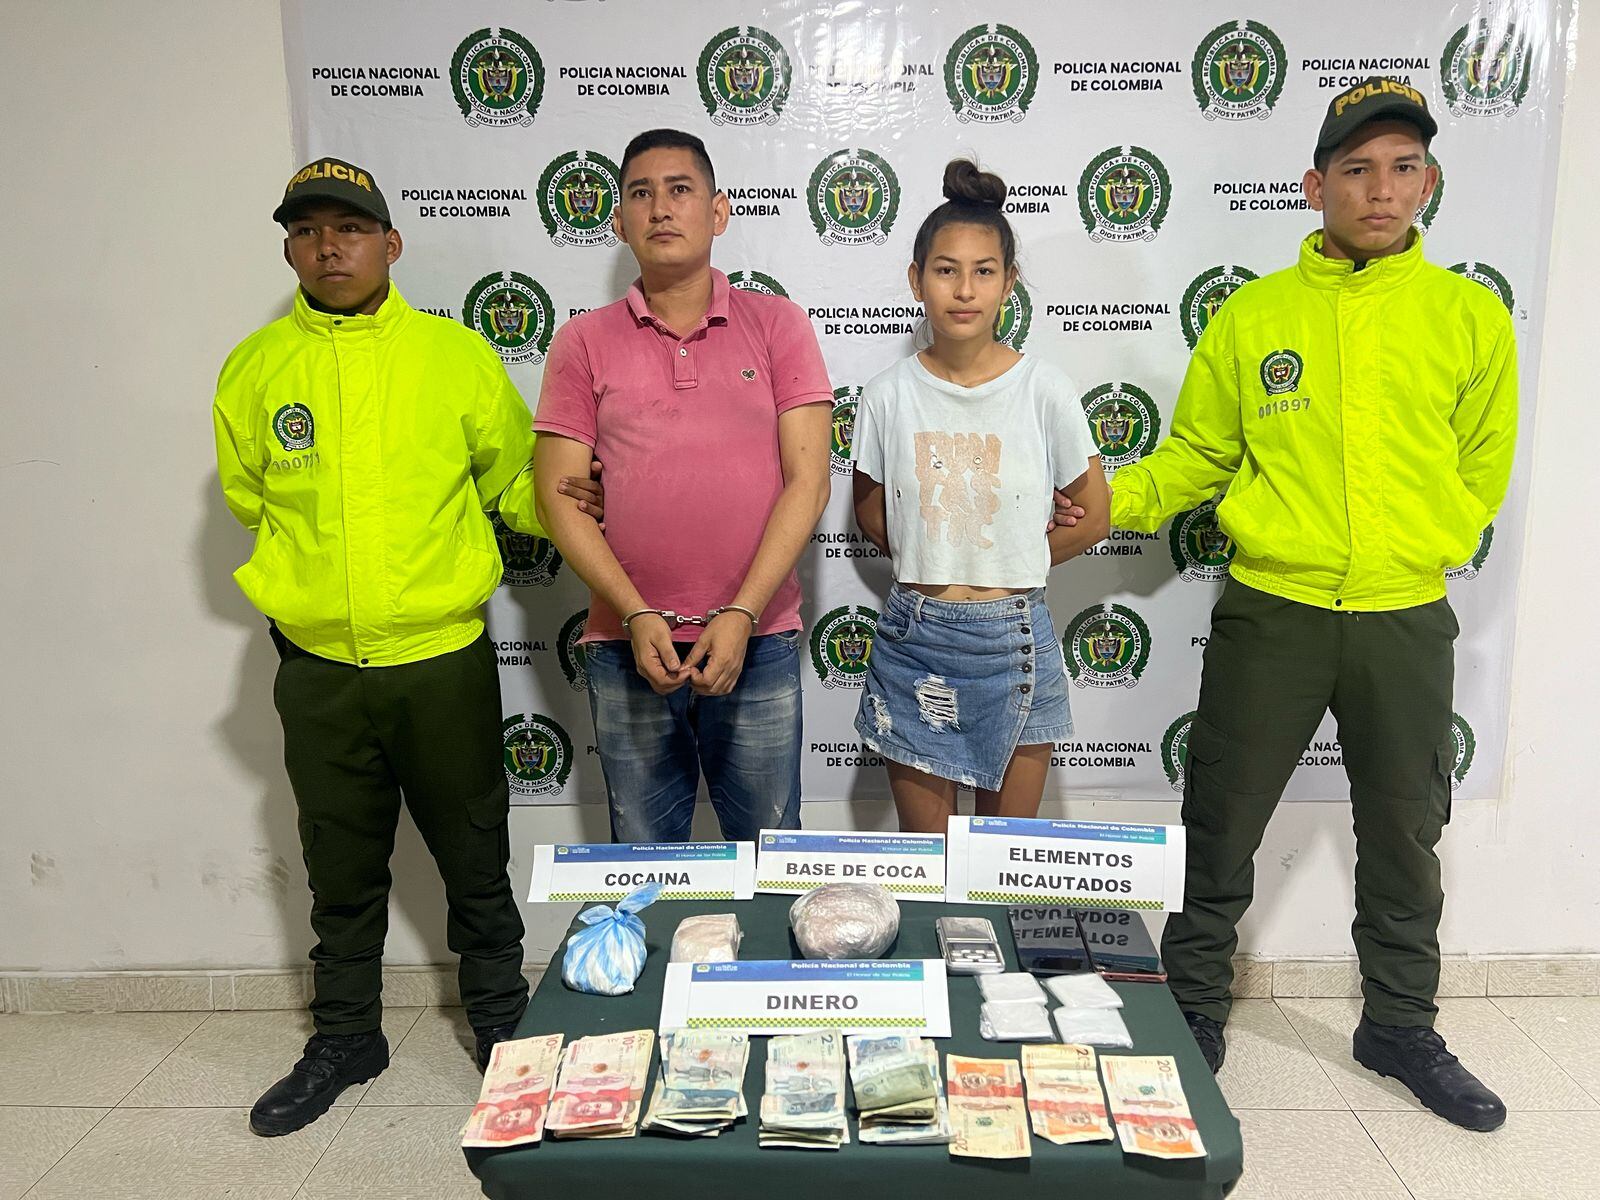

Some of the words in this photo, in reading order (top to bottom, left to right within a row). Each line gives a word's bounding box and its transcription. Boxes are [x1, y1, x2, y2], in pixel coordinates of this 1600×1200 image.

[956, 39, 981, 80] REPUBLICA
[1005, 39, 1027, 79] COLOMBIA
[1203, 35, 1230, 77] REPUBLICA
[1255, 36, 1275, 76] COLOMBIA
[462, 43, 485, 84] REPUBLICA
[509, 43, 533, 83] COLOMBIA
[1055, 63, 1107, 74] POLICIA
[1111, 62, 1181, 73] NACIONAL
[1303, 59, 1355, 70] POLICIA
[1359, 58, 1430, 69] NACIONAL
[313, 68, 365, 79] POLICIA
[369, 68, 440, 79] NACIONAL
[560, 67, 612, 78] POLICIA
[616, 67, 686, 78] NACIONAL
[1071, 80, 1087, 91] DE
[1091, 79, 1162, 90] COLOMBIA
[1319, 77, 1335, 87] DE
[331, 85, 347, 96] DE
[351, 85, 423, 96] COLOMBIA
[578, 85, 594, 95] DE
[598, 84, 669, 95] COLOMBIA
[991, 88, 1024, 112] NACIONAL
[1237, 85, 1271, 109] NACIONAL
[1335, 80, 1423, 116] POLICIA
[499, 92, 531, 116] NACIONAL
[990, 109, 1015, 121] PATRIA
[1236, 106, 1262, 118] PATRIA
[499, 113, 524, 125] PATRIA
[288, 162, 372, 193] POLICIA
[818, 163, 842, 203] REPUBLICA
[867, 164, 889, 203] COLOMBIA
[1089, 160, 1114, 200] REPUBLICA
[1139, 161, 1160, 200] COLOMBIA
[548, 165, 571, 205] REPUBLICA
[595, 166, 619, 204] COLOMBIA
[1008, 186, 1067, 196] ACIONAL
[1214, 183, 1265, 194] POLICIA
[1270, 183, 1302, 193] NACI
[402, 190, 454, 200] POLICIA
[457, 190, 527, 200] NACIONAL
[728, 188, 797, 199] NACIONAL
[730, 205, 780, 216] LOMBIA
[1006, 202, 1050, 213] OMBIA
[1230, 200, 1246, 210] DE
[1250, 199, 1312, 210] COLOMB
[420, 207, 436, 217] DE
[440, 206, 510, 217] COLOMBIA
[854, 211, 886, 234] NACIONAL
[1123, 208, 1156, 231] NACIONAL
[585, 216, 614, 236] NACIONA
[585, 233, 609, 245] PATRIA
[853, 232, 878, 243] PATRIA
[1123, 229, 1147, 240] PATRIA
[1191, 280, 1217, 318] REPUBLICA
[809, 308, 859, 318] POLICIA
[1047, 305, 1098, 315] POLICIA
[1102, 304, 1170, 314] NACIONAL
[825, 324, 840, 334] DE
[844, 324, 914, 334] COLOMBIA
[1064, 321, 1079, 331] DE
[1083, 320, 1152, 331] COLOMBIA
[1258, 398, 1310, 419] 001897
[826, 548, 840, 558] DE
[1084, 546, 1142, 556] OLOMBIA
[1073, 616, 1097, 651] REPUBLICA
[1120, 617, 1140, 651] COLOMBIA
[493, 642, 548, 651] ACIONAL
[500, 656, 532, 666] MBIA
[1106, 658, 1137, 679] NACIONAL
[1105, 676, 1129, 687] PATRIA
[811, 743, 859, 752] POLICIA
[1052, 743, 1084, 752] LICIA
[1087, 743, 1151, 752] NACIONAL
[827, 757, 841, 766] DE
[1051, 758, 1066, 766] DE
[1069, 758, 1135, 767] COLOMBIA
[1297, 757, 1341, 766] COLOM
[1010, 847, 1133, 868] ELEMENTOS
[786, 862, 835, 876] BASE
[842, 864, 866, 877] DE
[874, 865, 926, 878] COCA
[604, 872, 690, 886] COCAINA
[999, 872, 1132, 893] INCAUTADOS
[766, 995, 858, 1010] DINERO
